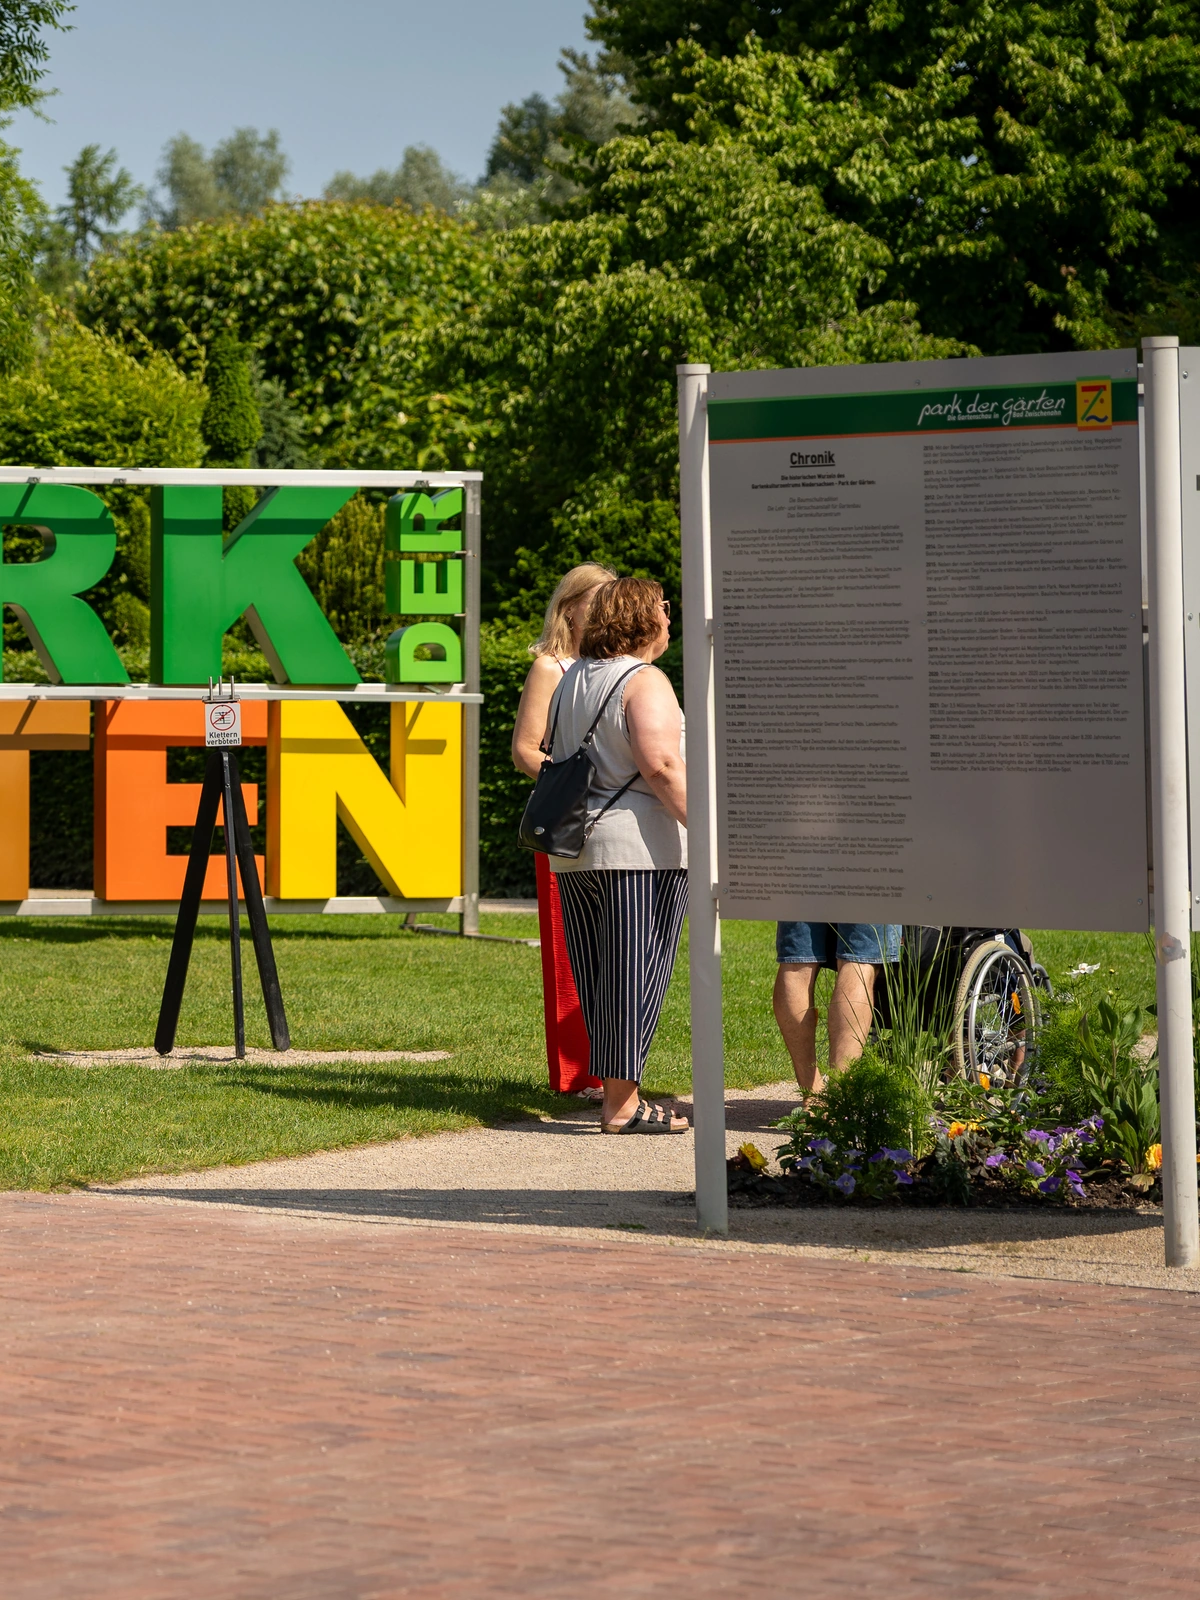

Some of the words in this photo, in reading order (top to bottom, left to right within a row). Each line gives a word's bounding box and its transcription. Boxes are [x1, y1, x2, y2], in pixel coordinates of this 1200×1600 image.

[917, 394, 961, 426] park
[967, 393, 999, 414] der
[1002, 389, 1066, 426] gärten
[1024, 410, 1062, 418] Zwischenahn
[790, 451, 835, 465] Chronik
[386, 488, 464, 683] DER
